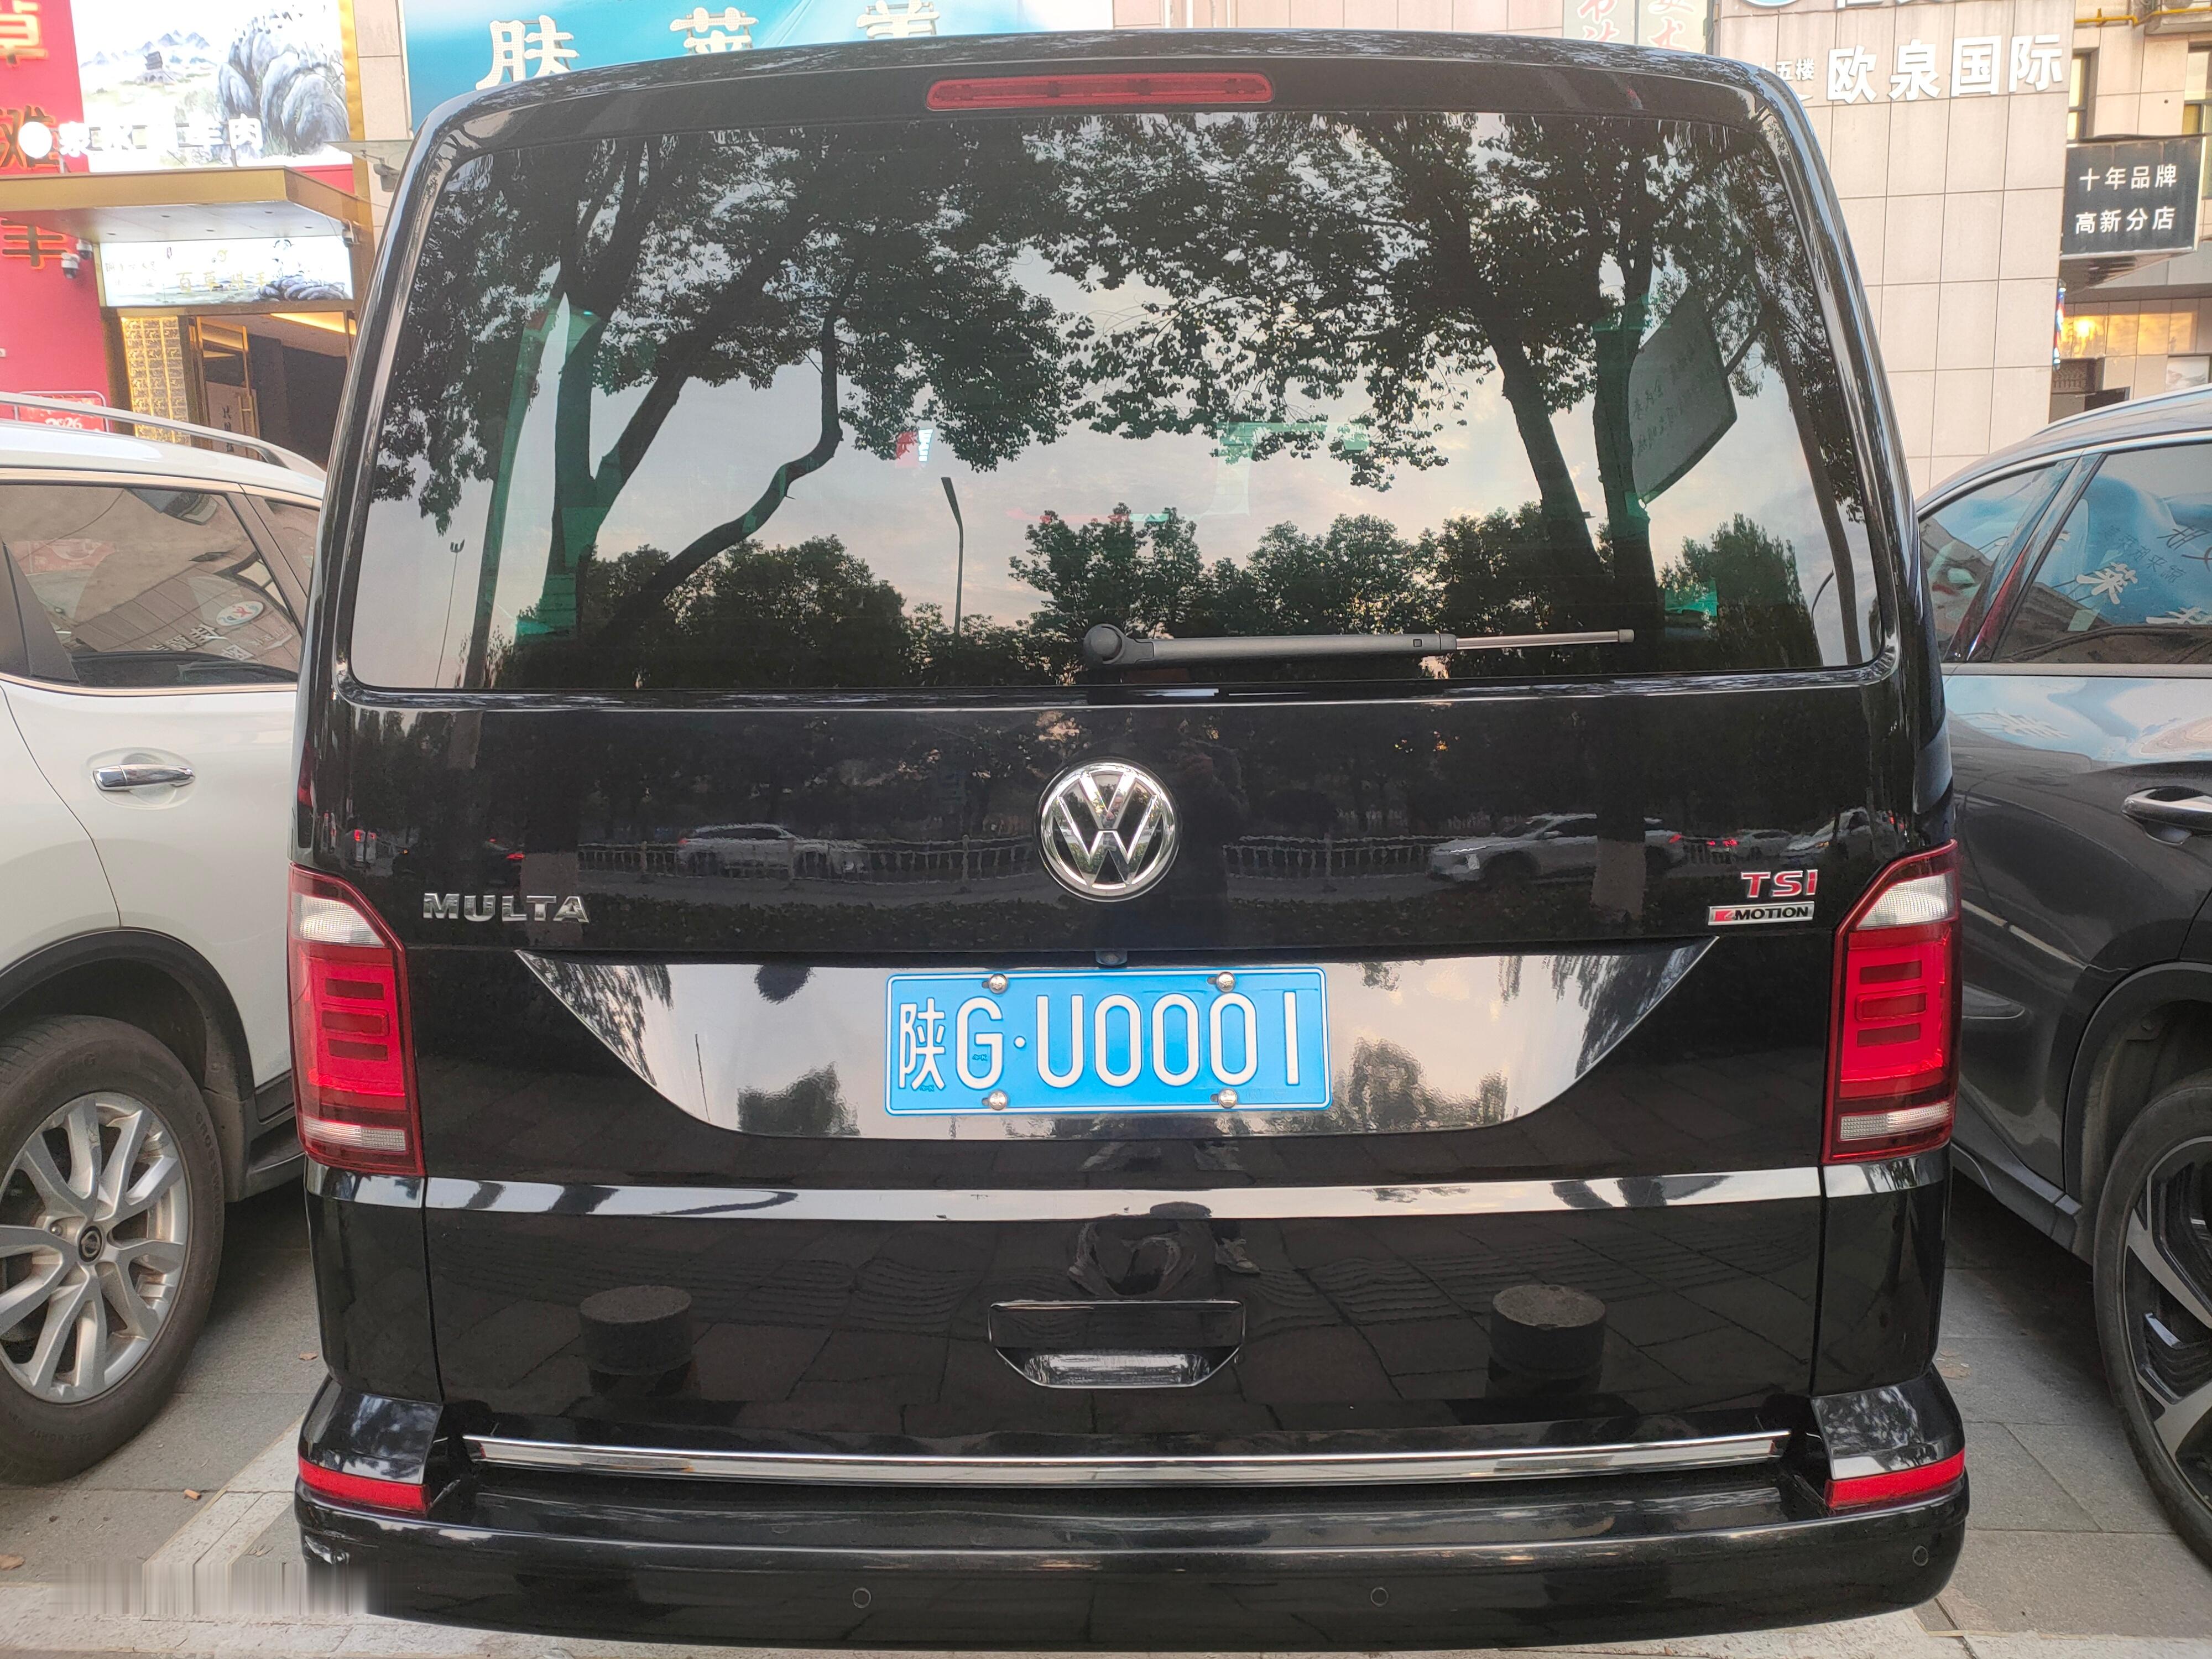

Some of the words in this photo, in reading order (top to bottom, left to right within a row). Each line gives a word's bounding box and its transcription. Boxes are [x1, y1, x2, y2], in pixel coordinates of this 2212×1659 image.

[1827, 34, 2063, 104] 欧泉国际
[2079, 164, 2177, 191] 十年品牌
[2075, 206, 2176, 234] 高新分店
[1741, 869, 1818, 898] TSI
[423, 893, 589, 923] MULTA
